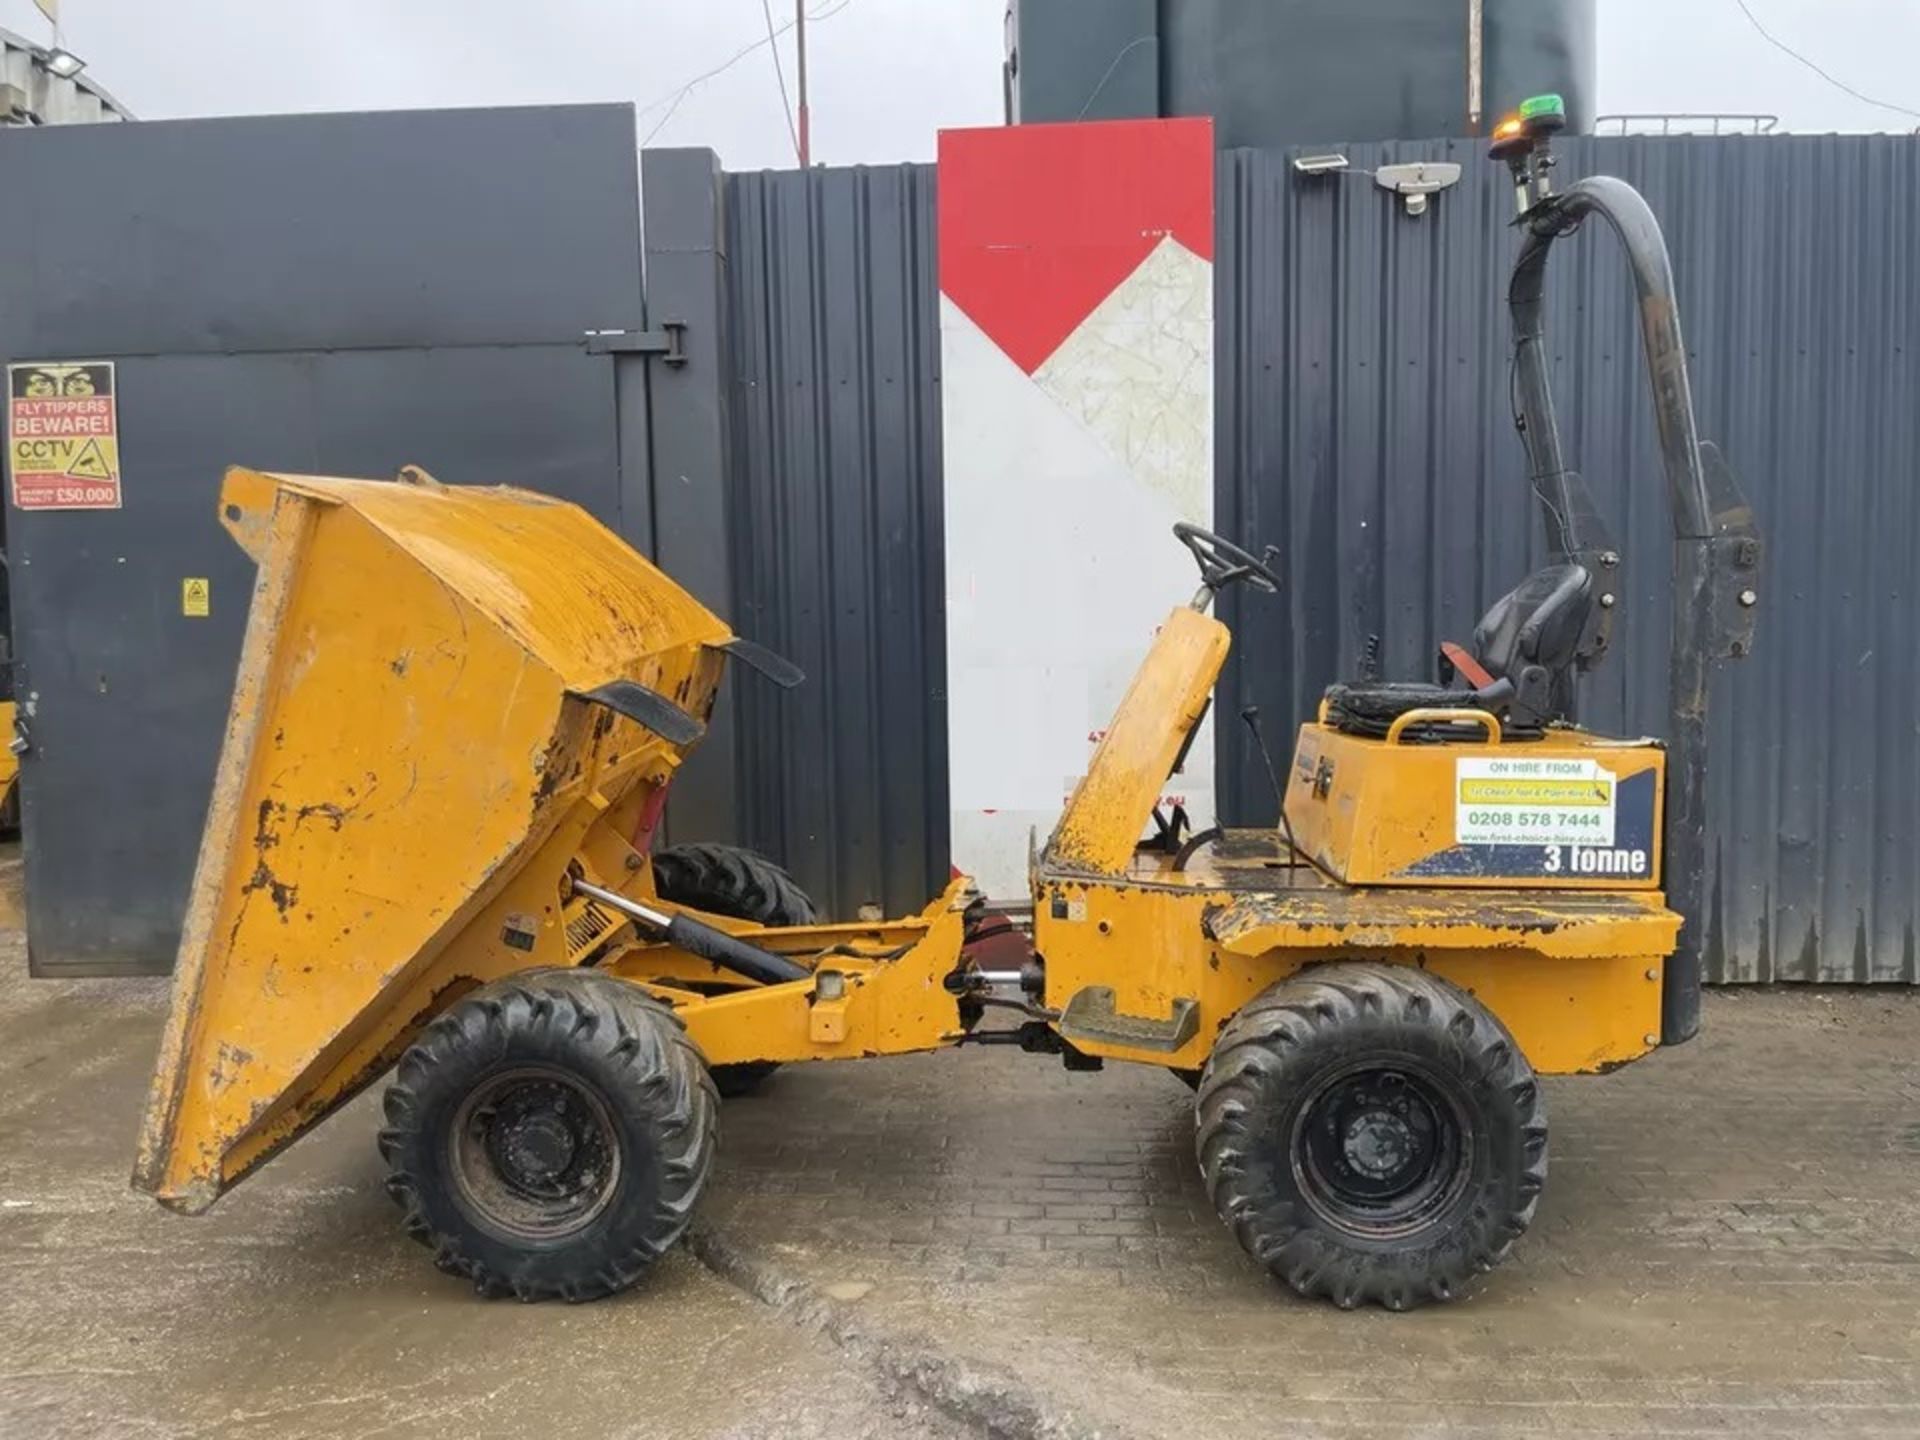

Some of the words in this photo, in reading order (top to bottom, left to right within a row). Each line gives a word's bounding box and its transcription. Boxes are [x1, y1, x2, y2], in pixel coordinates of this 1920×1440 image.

[15, 402, 43, 415] FLY
[45, 400, 108, 414] TIPPERS
[15, 416, 110, 435] BEWARE!
[17, 440, 74, 458] CCTV
[1490, 762, 1508, 773] ON
[1513, 763, 1541, 773] HIRE
[1546, 763, 1582, 774] FROM
[1469, 811, 1513, 826] 0208
[1519, 812, 1552, 827] 578
[1558, 813, 1601, 827] 7444
[1544, 845, 1561, 873] 3
